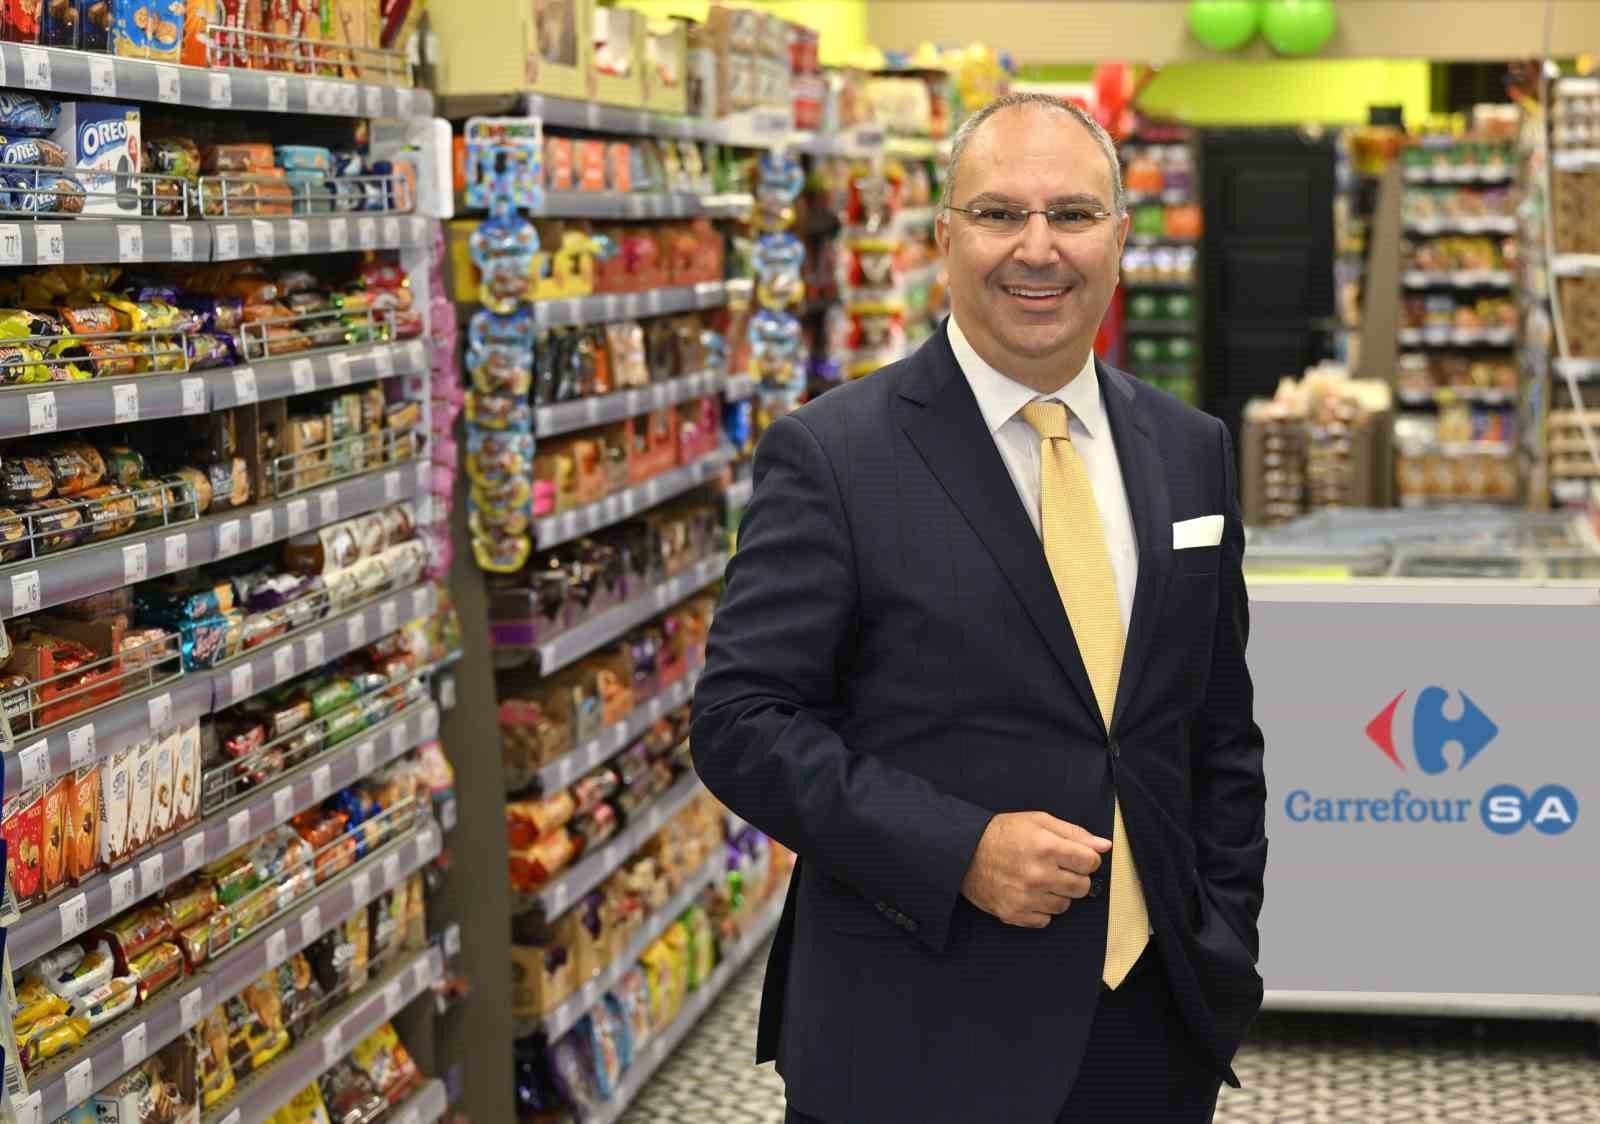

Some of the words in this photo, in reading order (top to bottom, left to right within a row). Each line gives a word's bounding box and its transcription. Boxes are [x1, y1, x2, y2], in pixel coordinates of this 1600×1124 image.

[4, 143, 39, 164] OREO
[83, 121, 126, 156] OREO
[1284, 788, 1472, 823] Carrefour
[1486, 793, 1574, 827] SA
